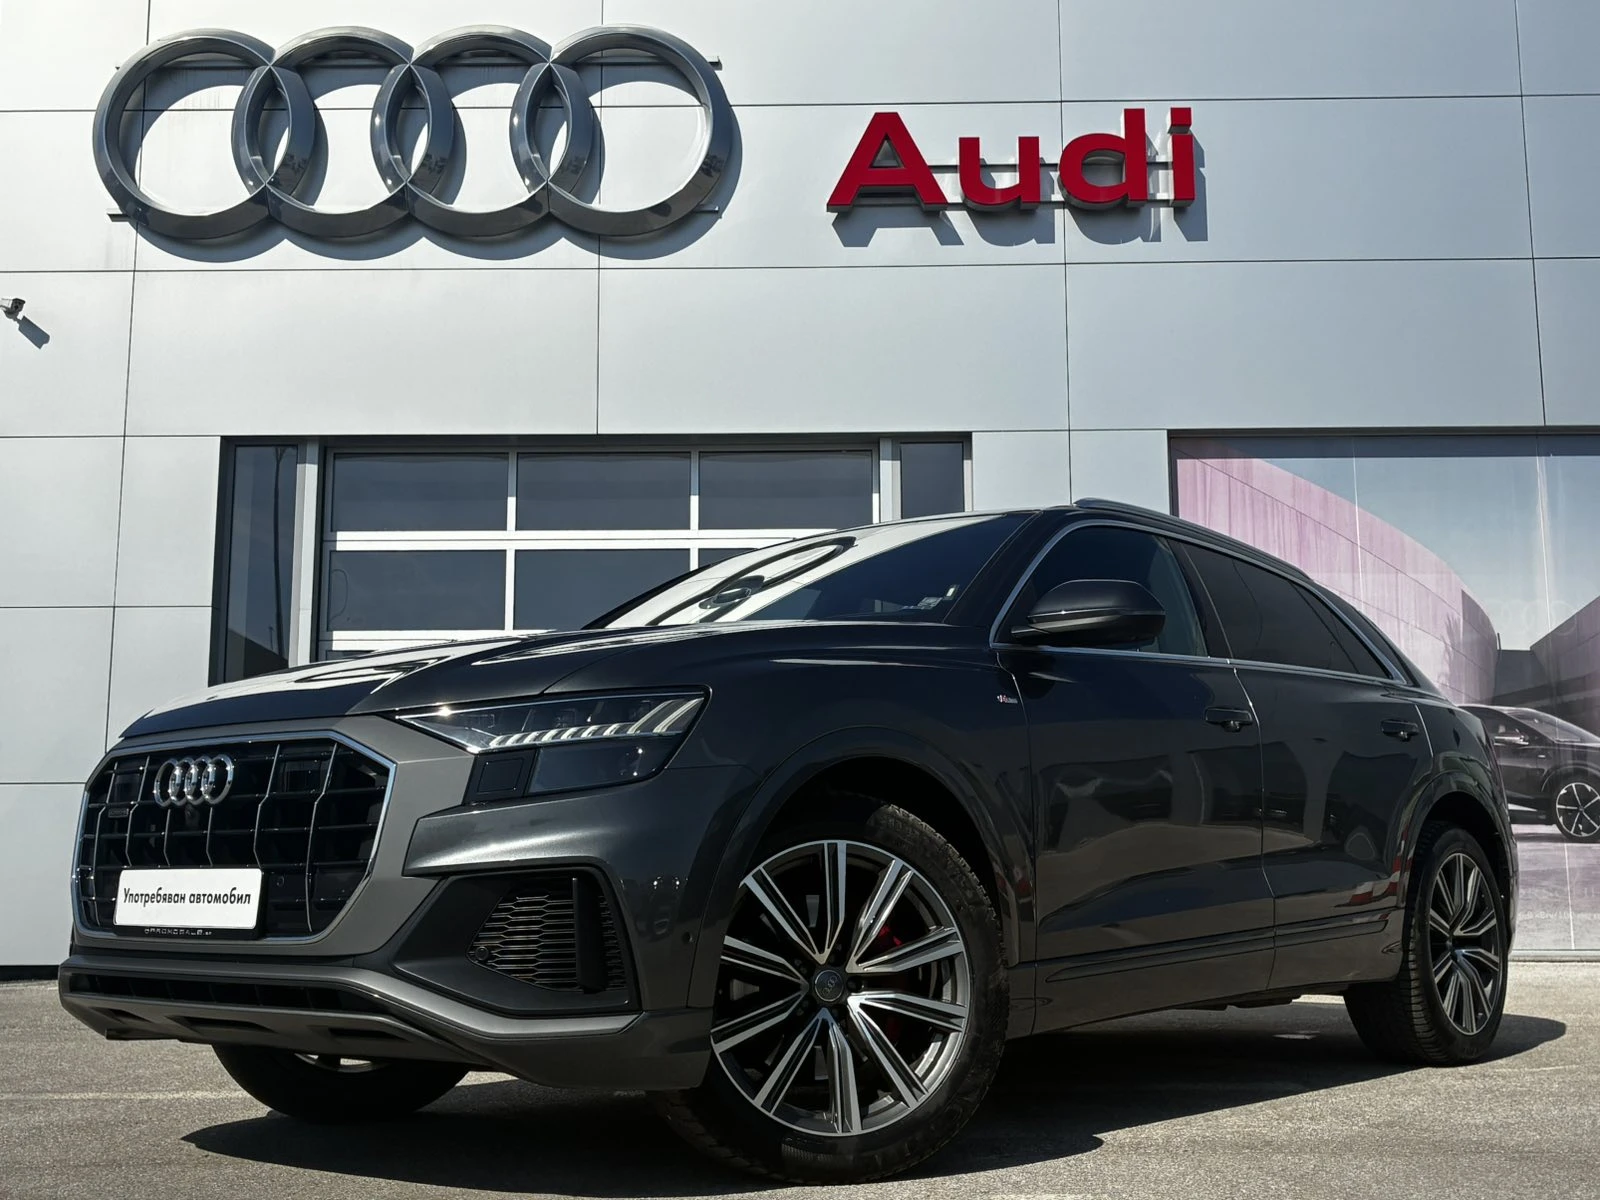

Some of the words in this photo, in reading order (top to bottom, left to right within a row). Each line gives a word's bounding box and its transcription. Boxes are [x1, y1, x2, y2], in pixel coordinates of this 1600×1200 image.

[827, 107, 1196, 212] Audi
[123, 887, 186, 907] Употребяван
[188, 887, 251, 905] автомобил
